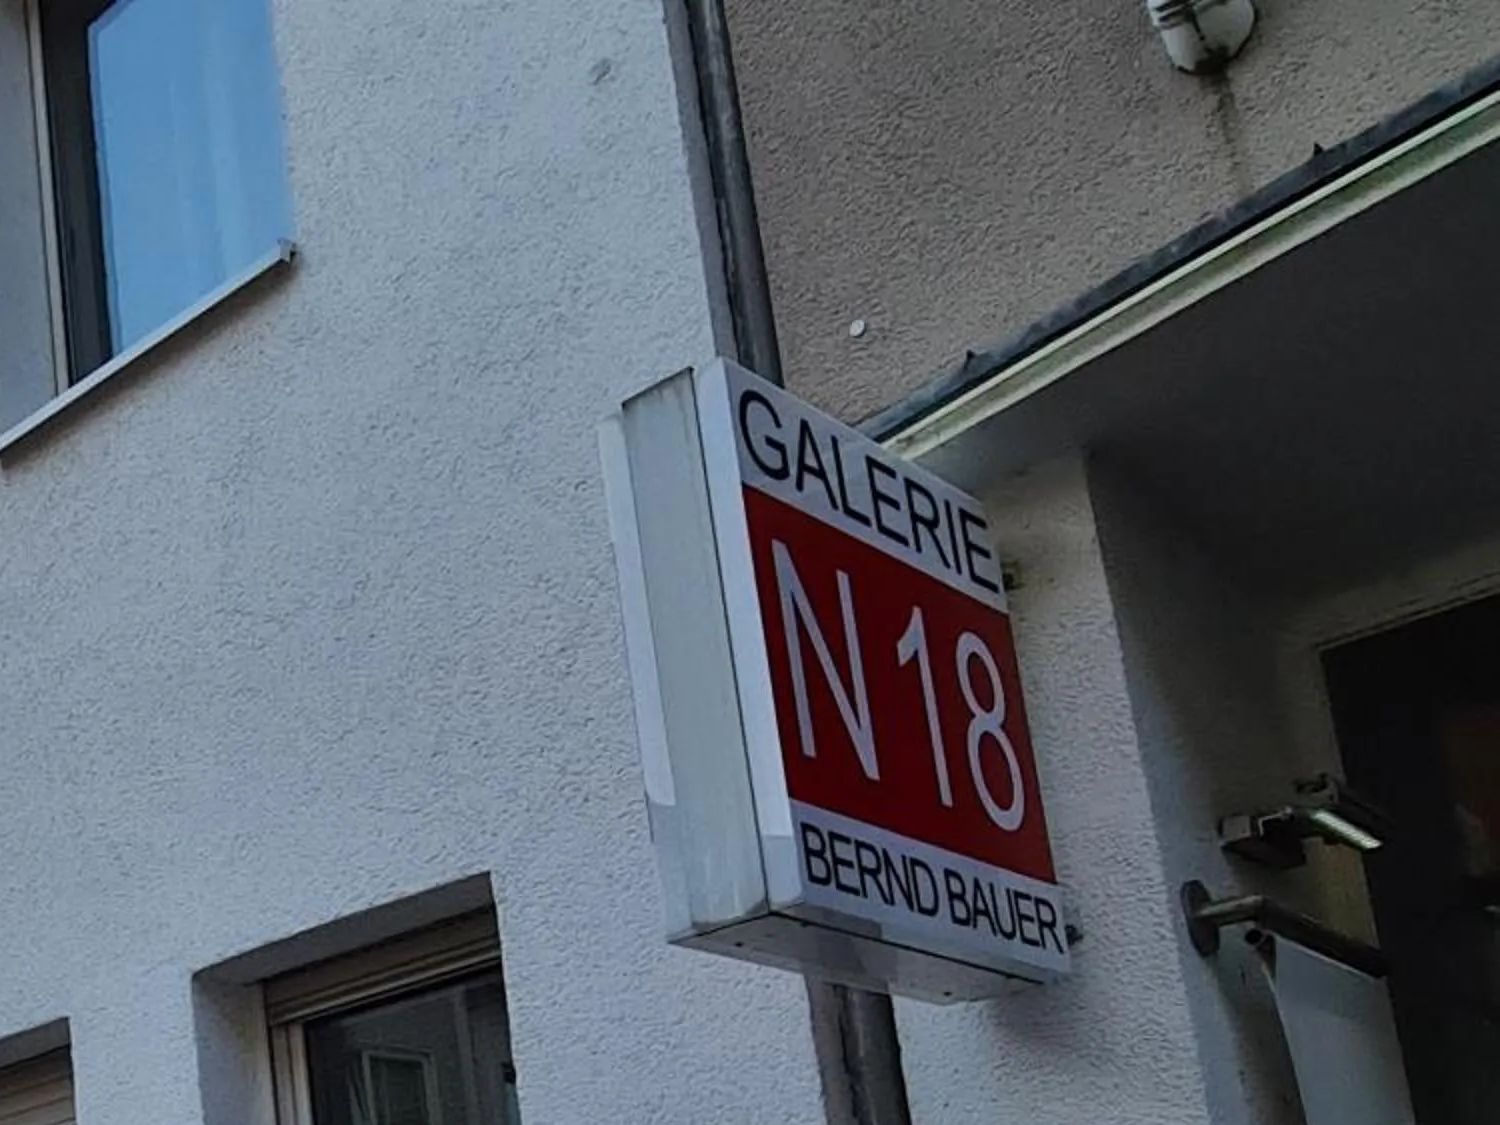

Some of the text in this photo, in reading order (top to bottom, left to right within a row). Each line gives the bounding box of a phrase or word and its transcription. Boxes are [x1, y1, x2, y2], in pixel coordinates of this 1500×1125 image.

[738, 389, 999, 594] GALERIE
[771, 538, 1026, 833] N 18
[800, 821, 1065, 955] BERND BAUER
